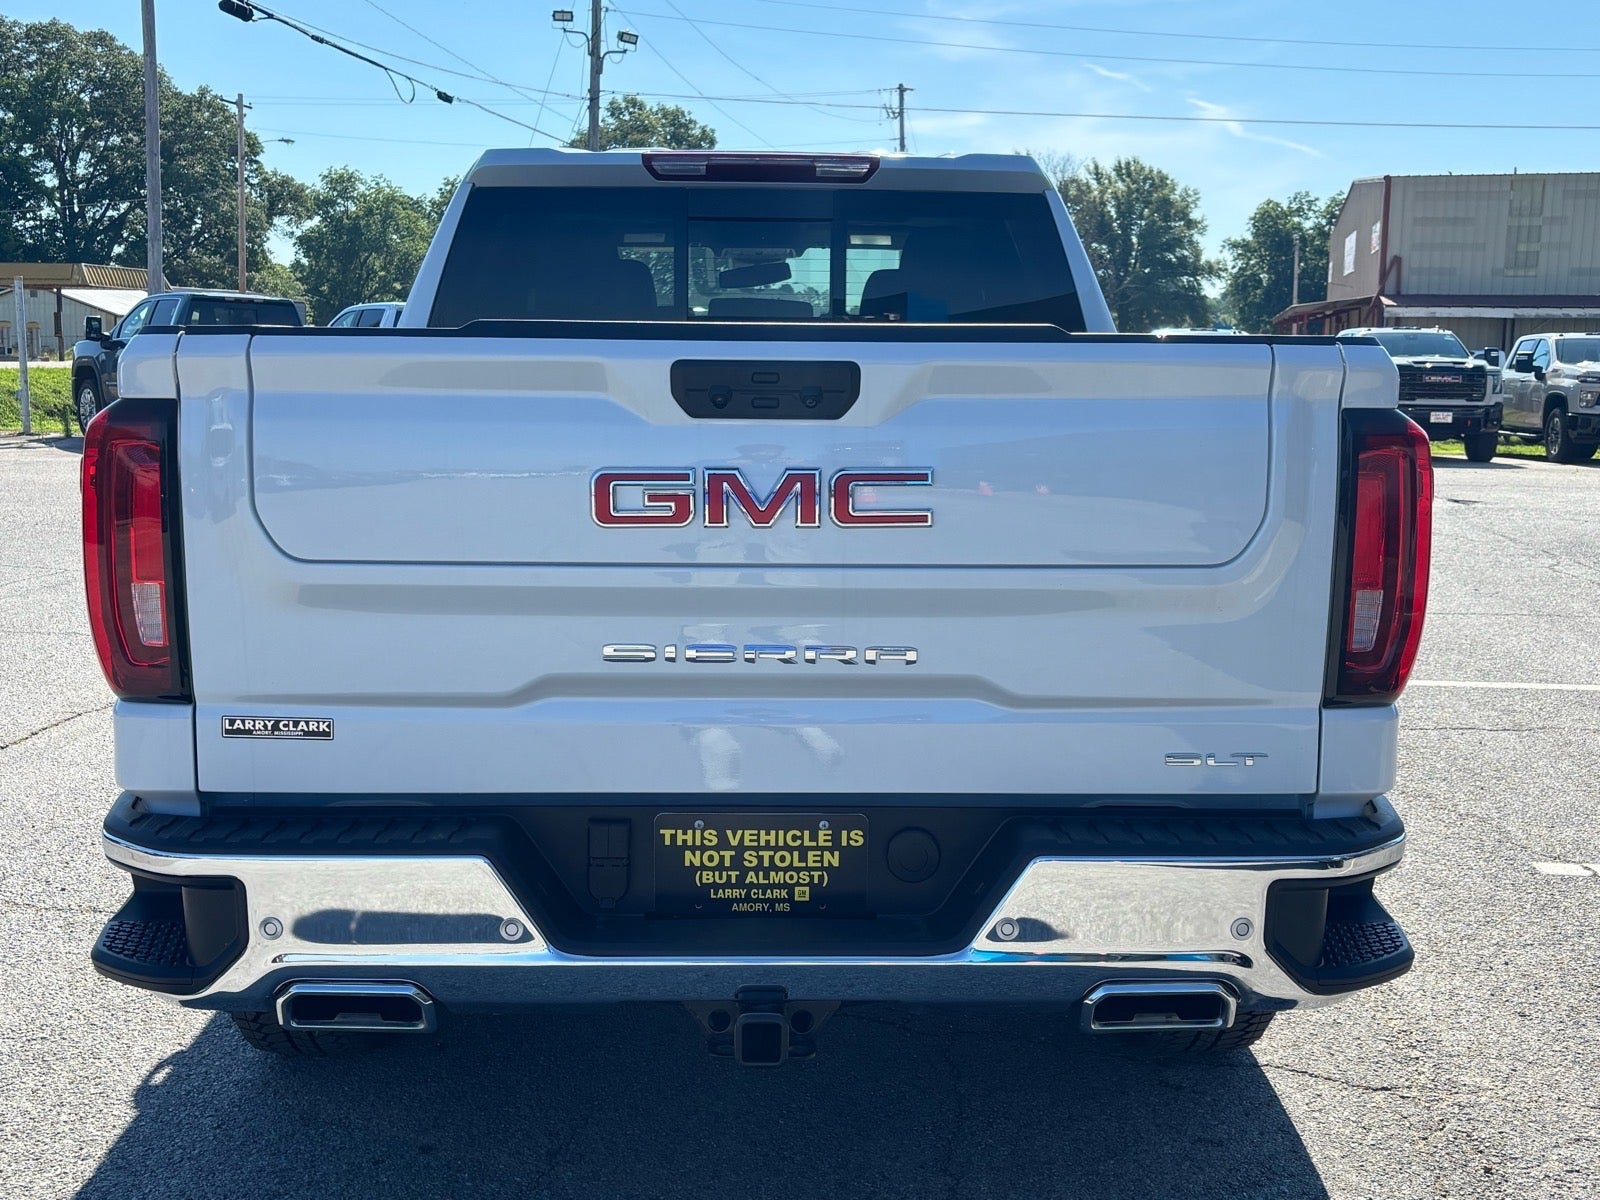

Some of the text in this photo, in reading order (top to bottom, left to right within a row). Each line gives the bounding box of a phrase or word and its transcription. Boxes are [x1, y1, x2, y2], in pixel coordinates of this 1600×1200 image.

[590, 467, 934, 528] GMC
[602, 644, 918, 664] SIERRA
[225, 719, 330, 732] LARRY CLARK
[1165, 752, 1269, 766] SLT
[660, 829, 865, 847] THIS VEHICLE IS
[684, 850, 840, 867] NOT STOLEN
[695, 870, 828, 887] (BUT ALMOST)
[710, 888, 789, 899] LARRY CLARK
[731, 903, 791, 912] AMORY, MS
